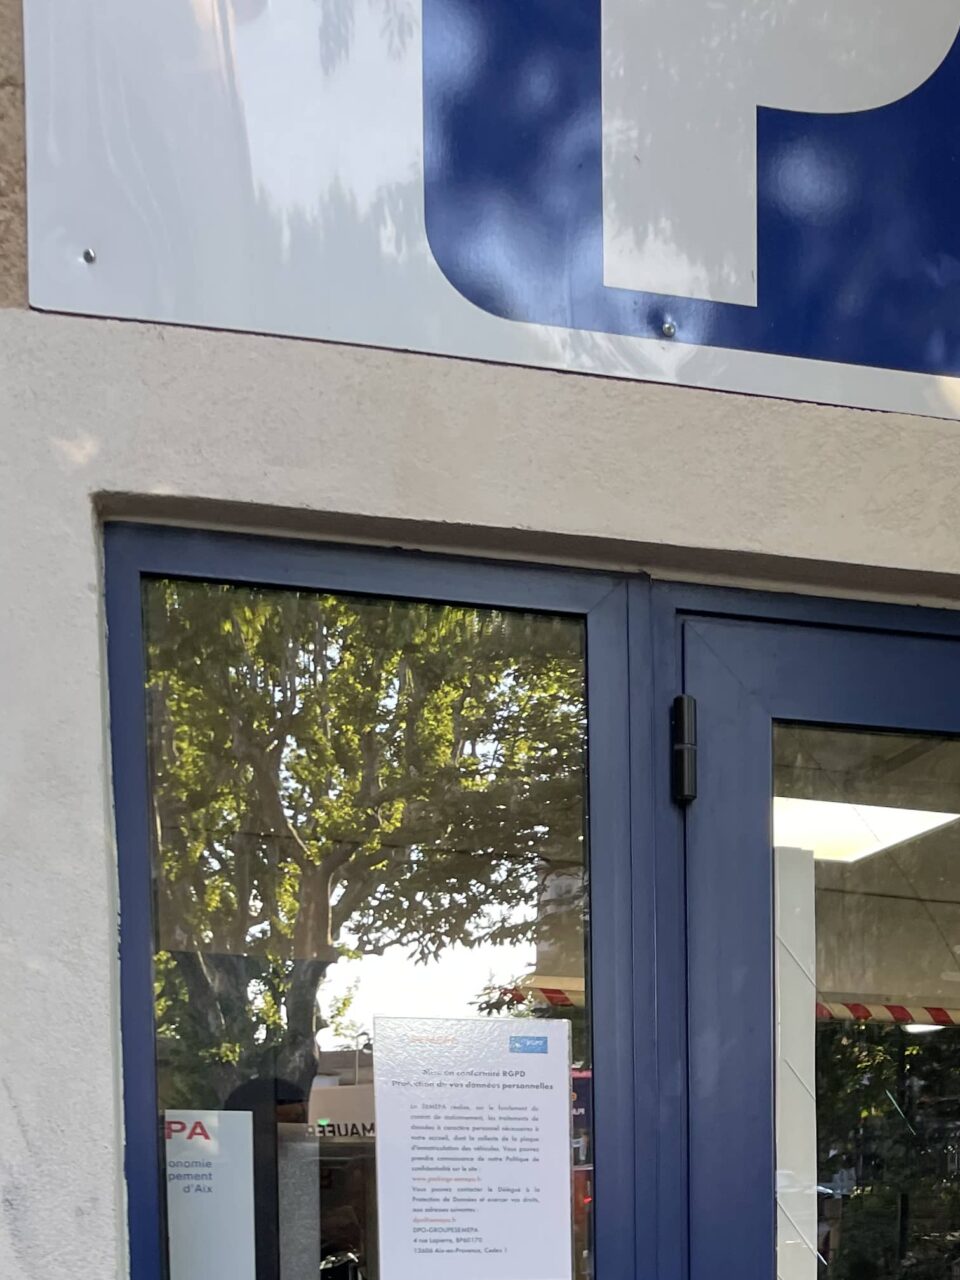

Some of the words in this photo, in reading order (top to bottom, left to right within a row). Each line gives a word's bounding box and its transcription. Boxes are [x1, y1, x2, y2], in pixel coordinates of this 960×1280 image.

[502, 1082, 554, 1091] personnelles
[168, 1172, 212, 1183] pement
[183, 1184, 213, 1193] d'Aix
